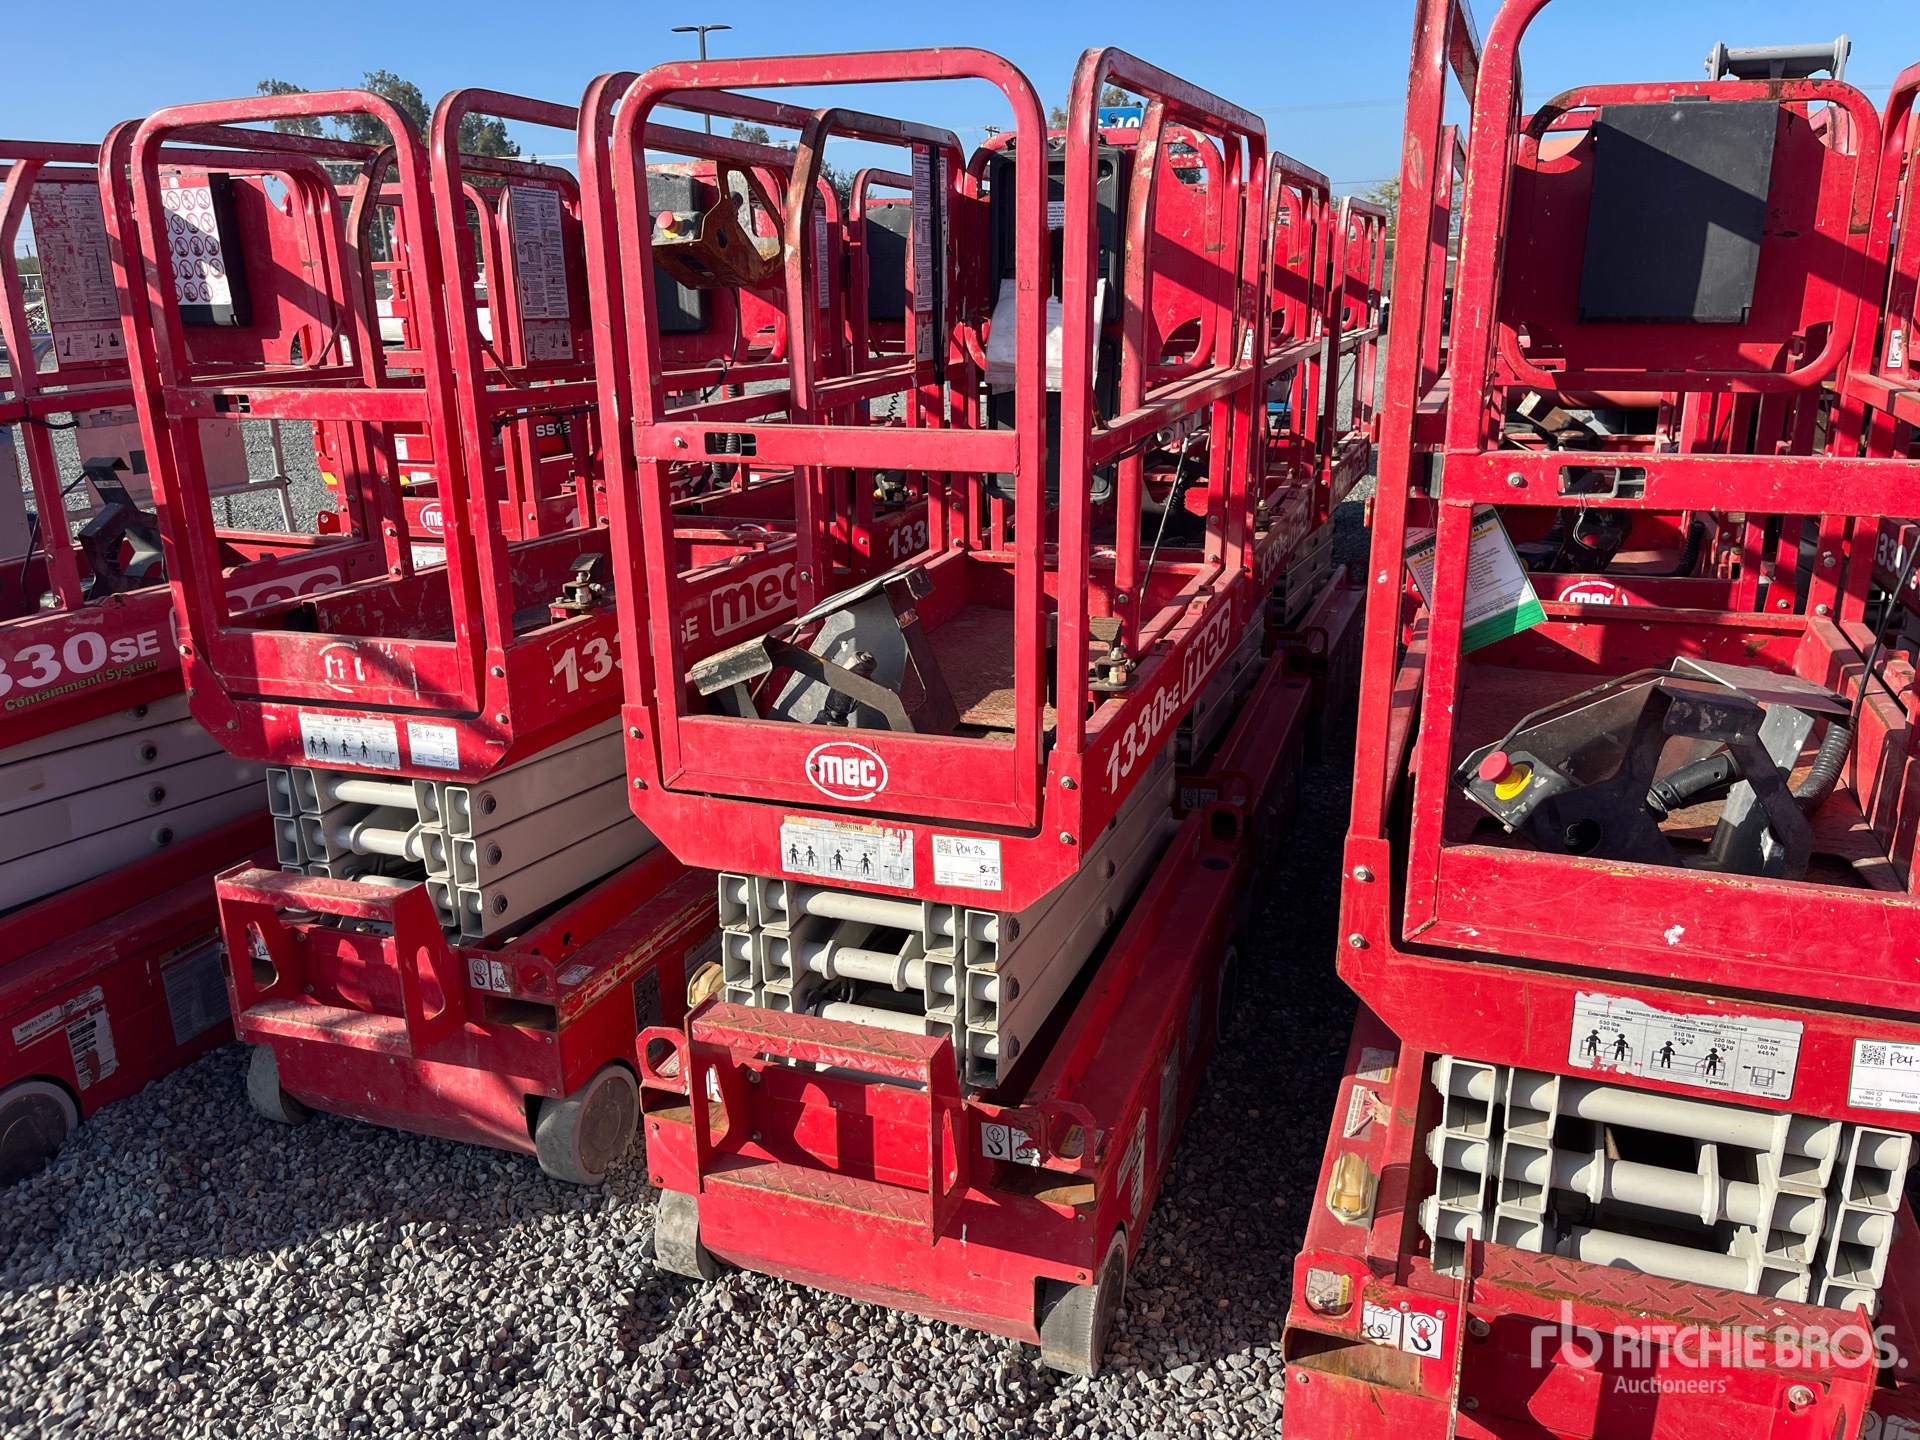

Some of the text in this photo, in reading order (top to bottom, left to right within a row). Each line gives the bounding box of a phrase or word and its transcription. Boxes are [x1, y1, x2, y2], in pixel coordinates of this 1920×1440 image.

[889, 520, 929, 559] 133
[5, 659, 158, 712] Containment System
[1587, 1010, 1633, 1022] Extension retracted
[1625, 1009, 1748, 1032] Maximum platform capacity evenly distributed
[1673, 1024, 1722, 1035] Extension extended
[1709, 1079, 1729, 1087] person
[1889, 1097, 1918, 1105] Inspection
